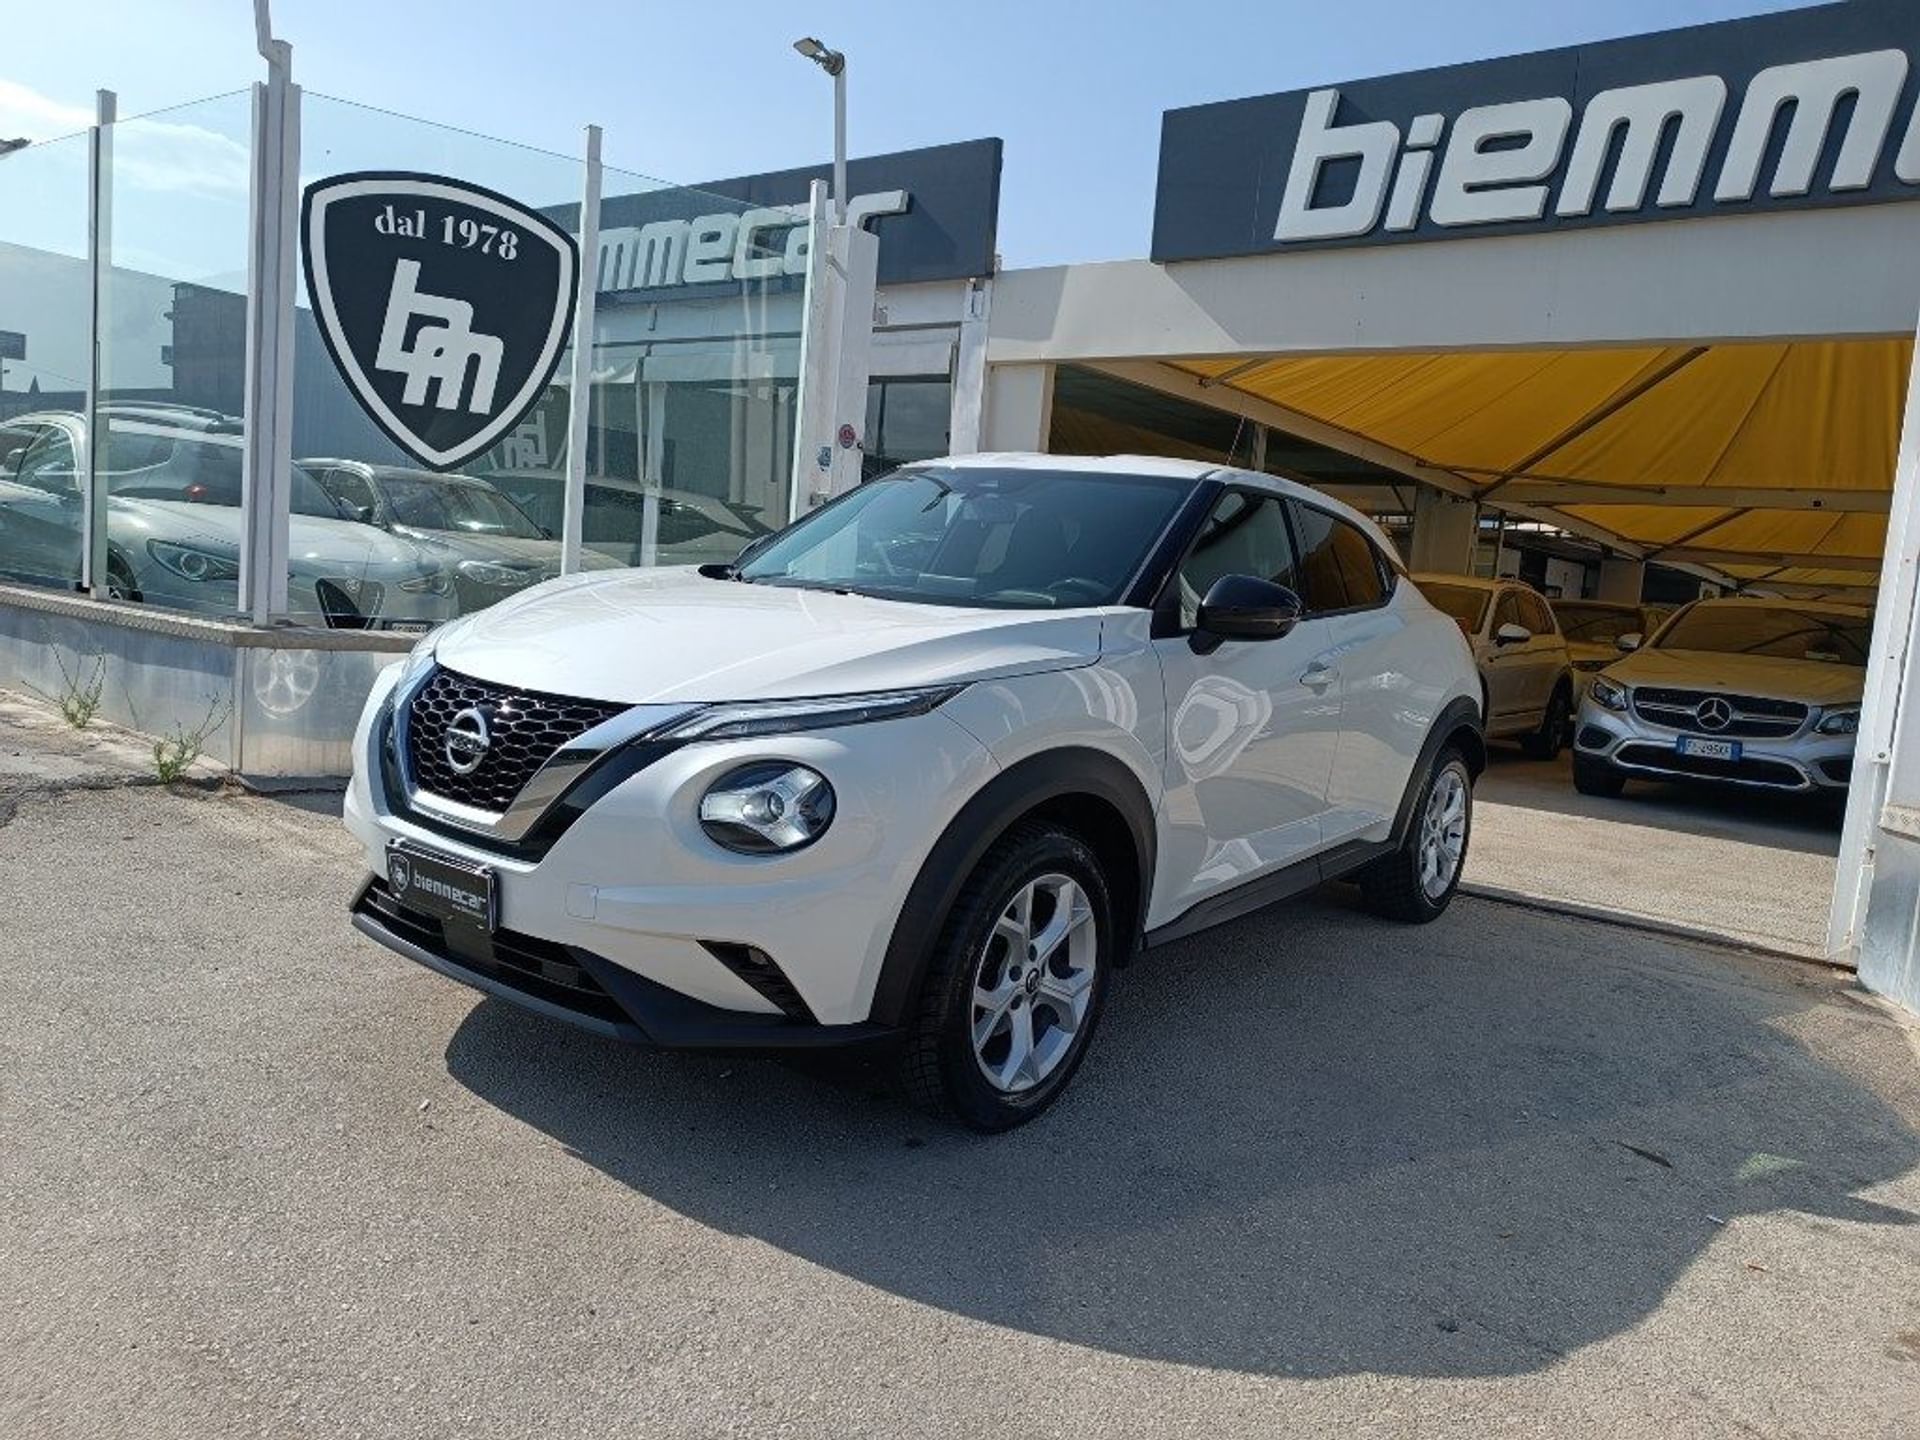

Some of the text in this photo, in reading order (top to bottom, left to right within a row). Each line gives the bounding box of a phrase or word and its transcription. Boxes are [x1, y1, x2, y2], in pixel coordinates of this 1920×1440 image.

[1274, 49, 1919, 242] biemm
[374, 205, 518, 260] dal 1978
